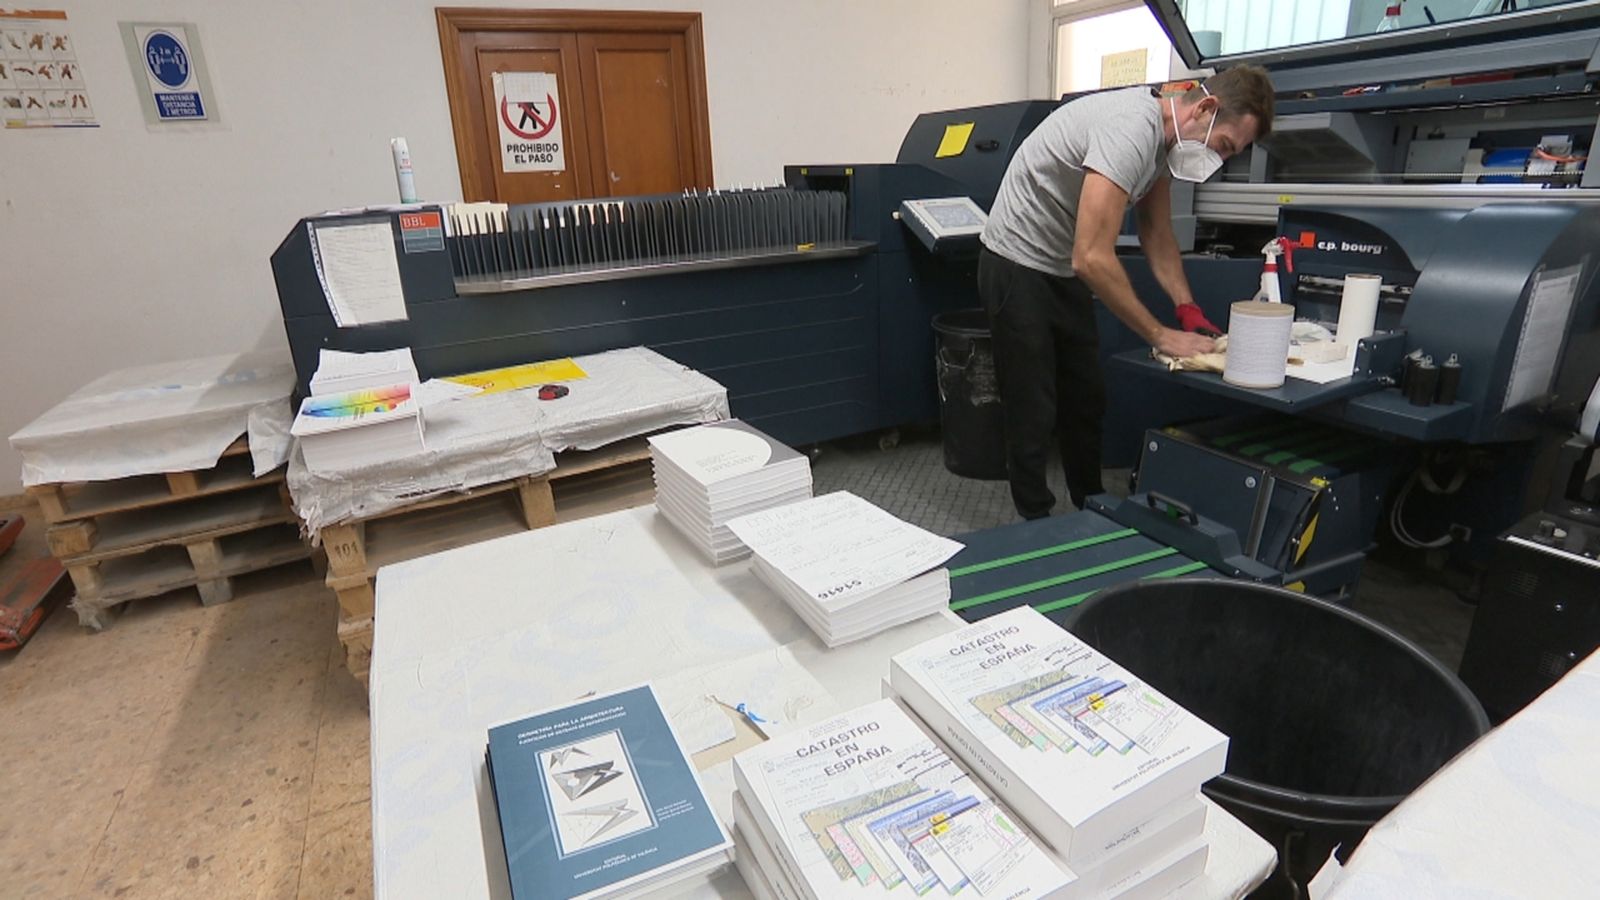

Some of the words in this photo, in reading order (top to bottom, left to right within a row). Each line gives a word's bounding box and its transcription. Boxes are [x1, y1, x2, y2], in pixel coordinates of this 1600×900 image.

[506, 143, 559, 153] PROHIBIDO
[514, 154, 526, 164] EL
[528, 154, 554, 163] PASO
[1341, 241, 1382, 254] bourg
[949, 626, 1020, 656] CATASTRO
[984, 642, 1006, 655] EN
[978, 644, 1037, 670] ESPAÑA
[554, 721, 570, 730] PARA
[580, 706, 624, 722] ARQUITECTURA
[796, 721, 880, 758] CATASTRO
[834, 742, 860, 758] EN
[824, 745, 892, 776] ESPAÑA
